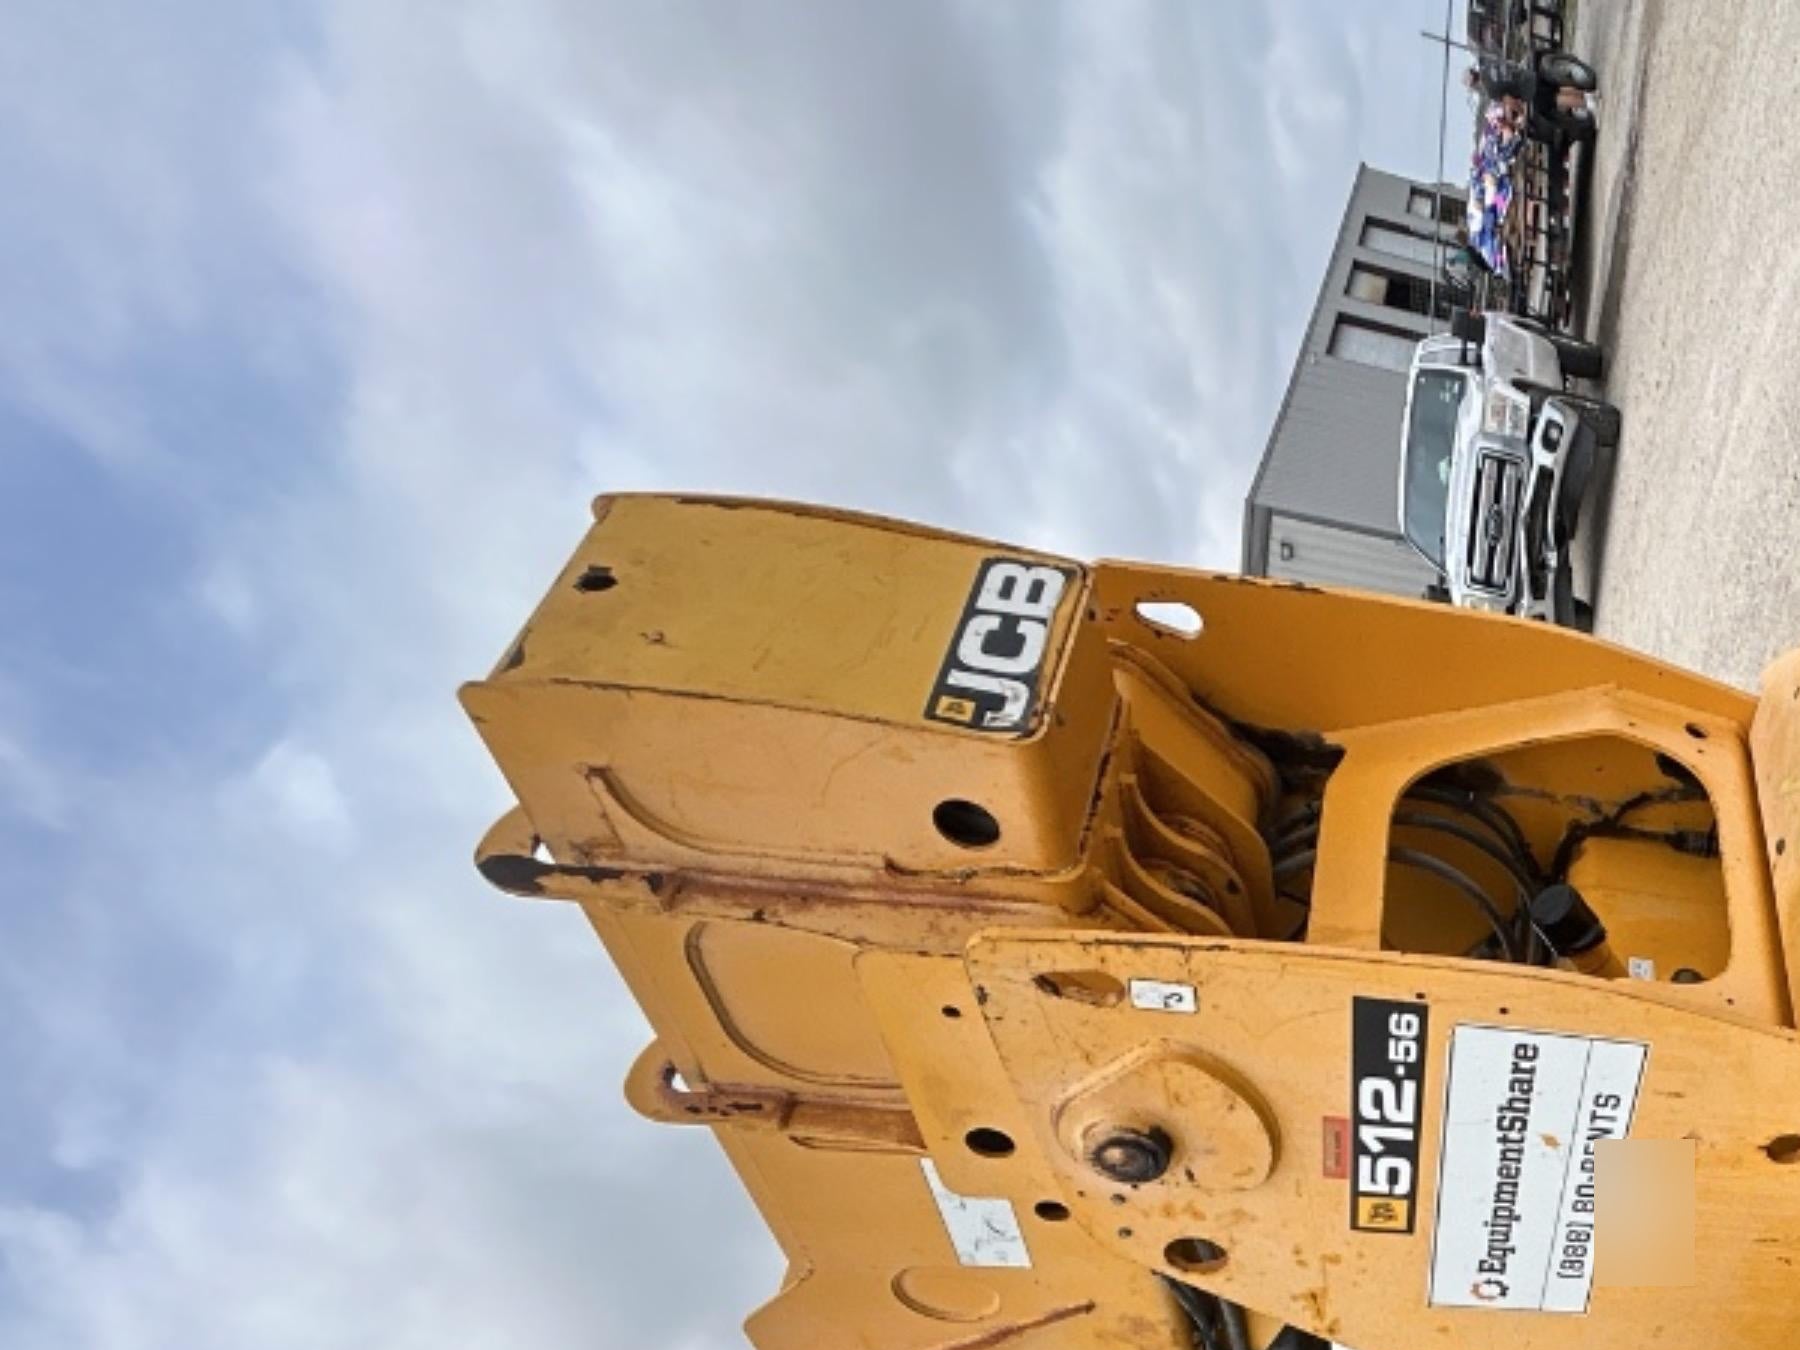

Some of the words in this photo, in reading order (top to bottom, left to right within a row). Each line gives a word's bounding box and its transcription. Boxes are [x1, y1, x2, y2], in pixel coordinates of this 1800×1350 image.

[947, 562, 1066, 728] JCB
[1477, 1042, 1540, 1276] EquipmentShare
[1557, 1221, 1595, 1280] (888)
